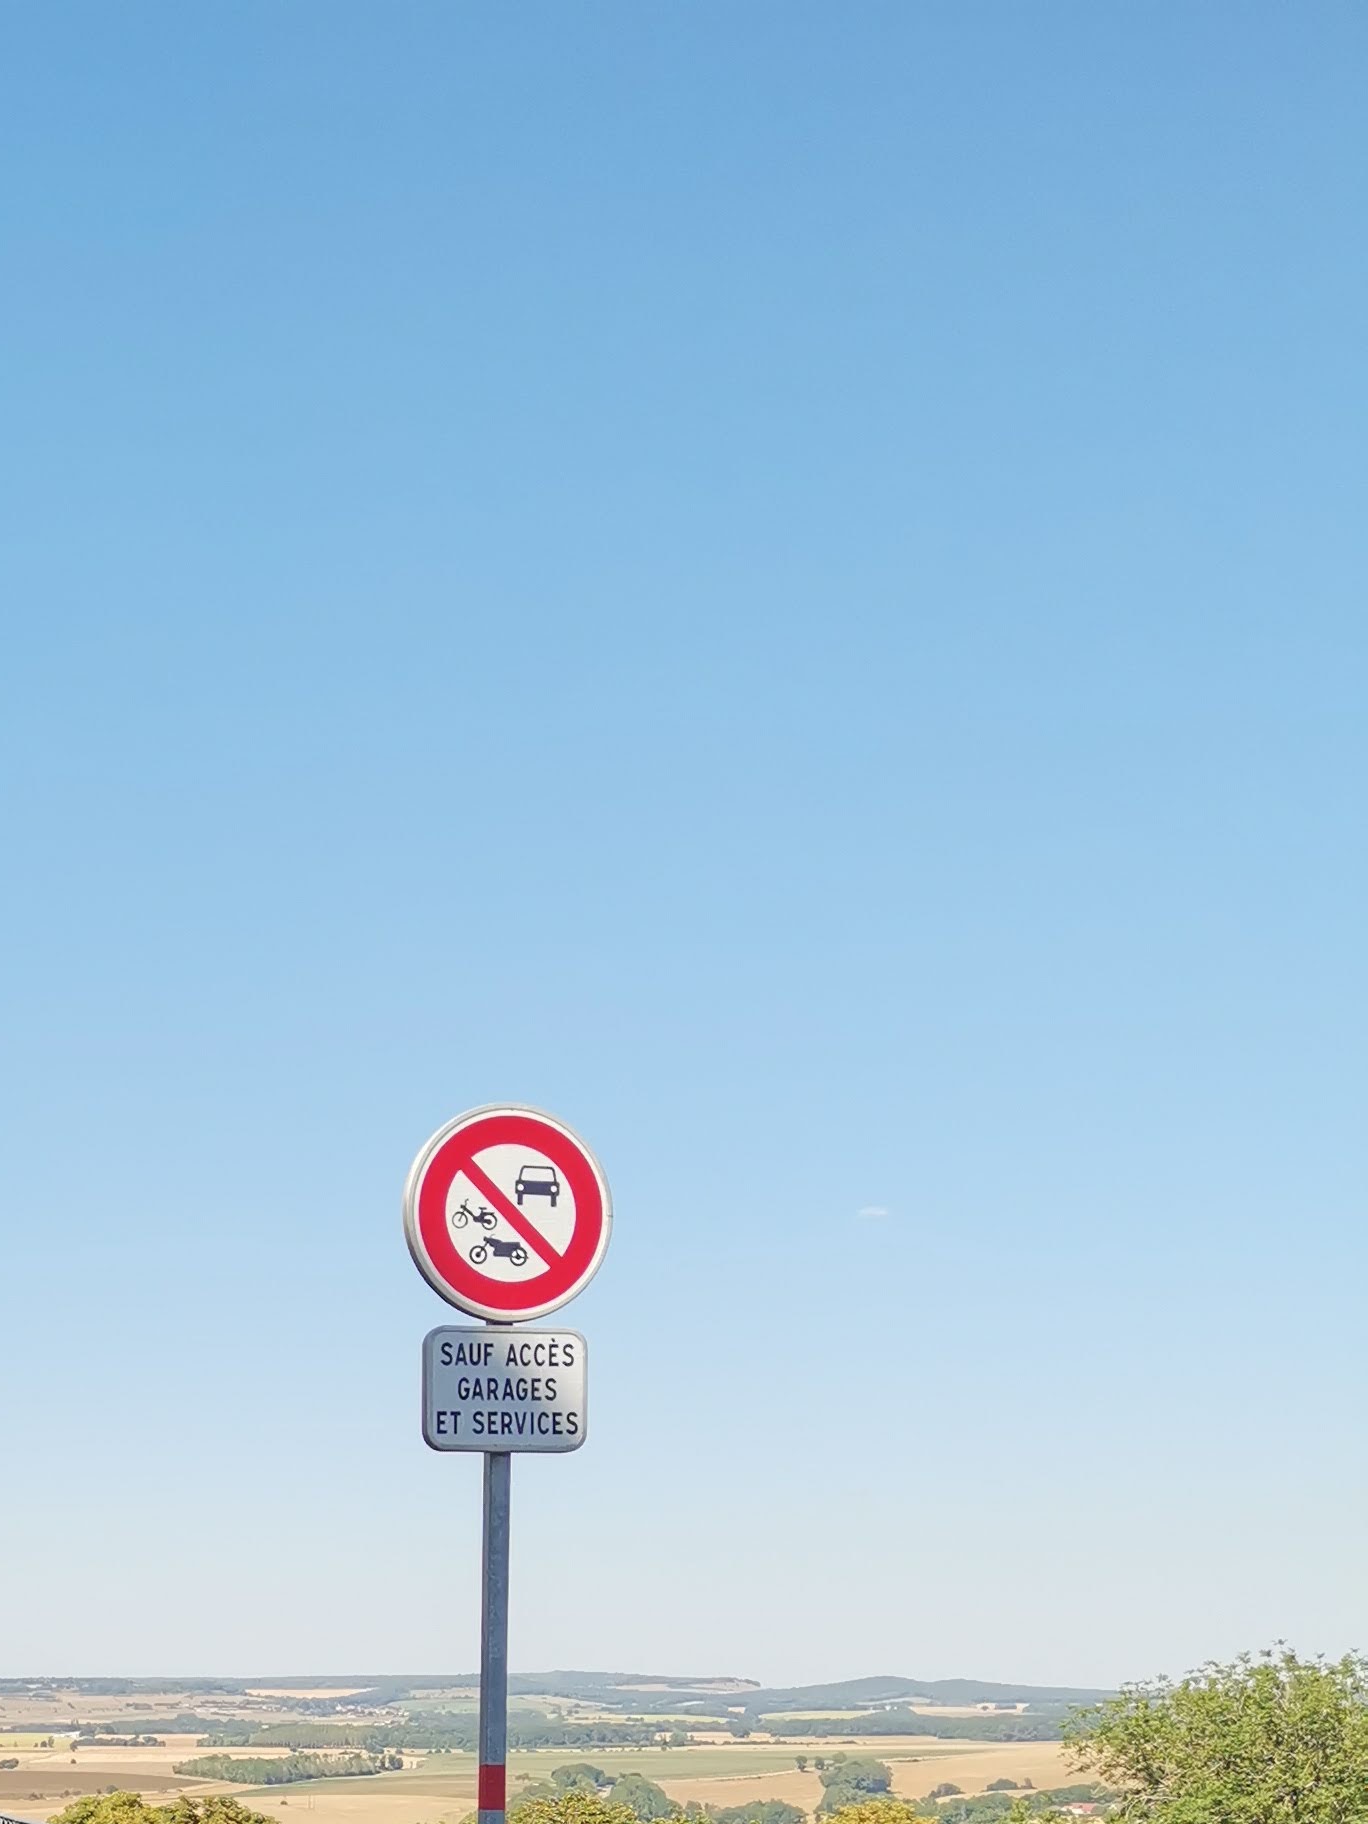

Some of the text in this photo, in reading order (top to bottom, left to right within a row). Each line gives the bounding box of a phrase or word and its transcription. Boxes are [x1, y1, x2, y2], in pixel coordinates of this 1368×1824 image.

[440, 1337, 574, 1367] SAUF ACCÈS
[457, 1377, 557, 1402] GARAGES
[436, 1410, 578, 1435] ET SERVICES
